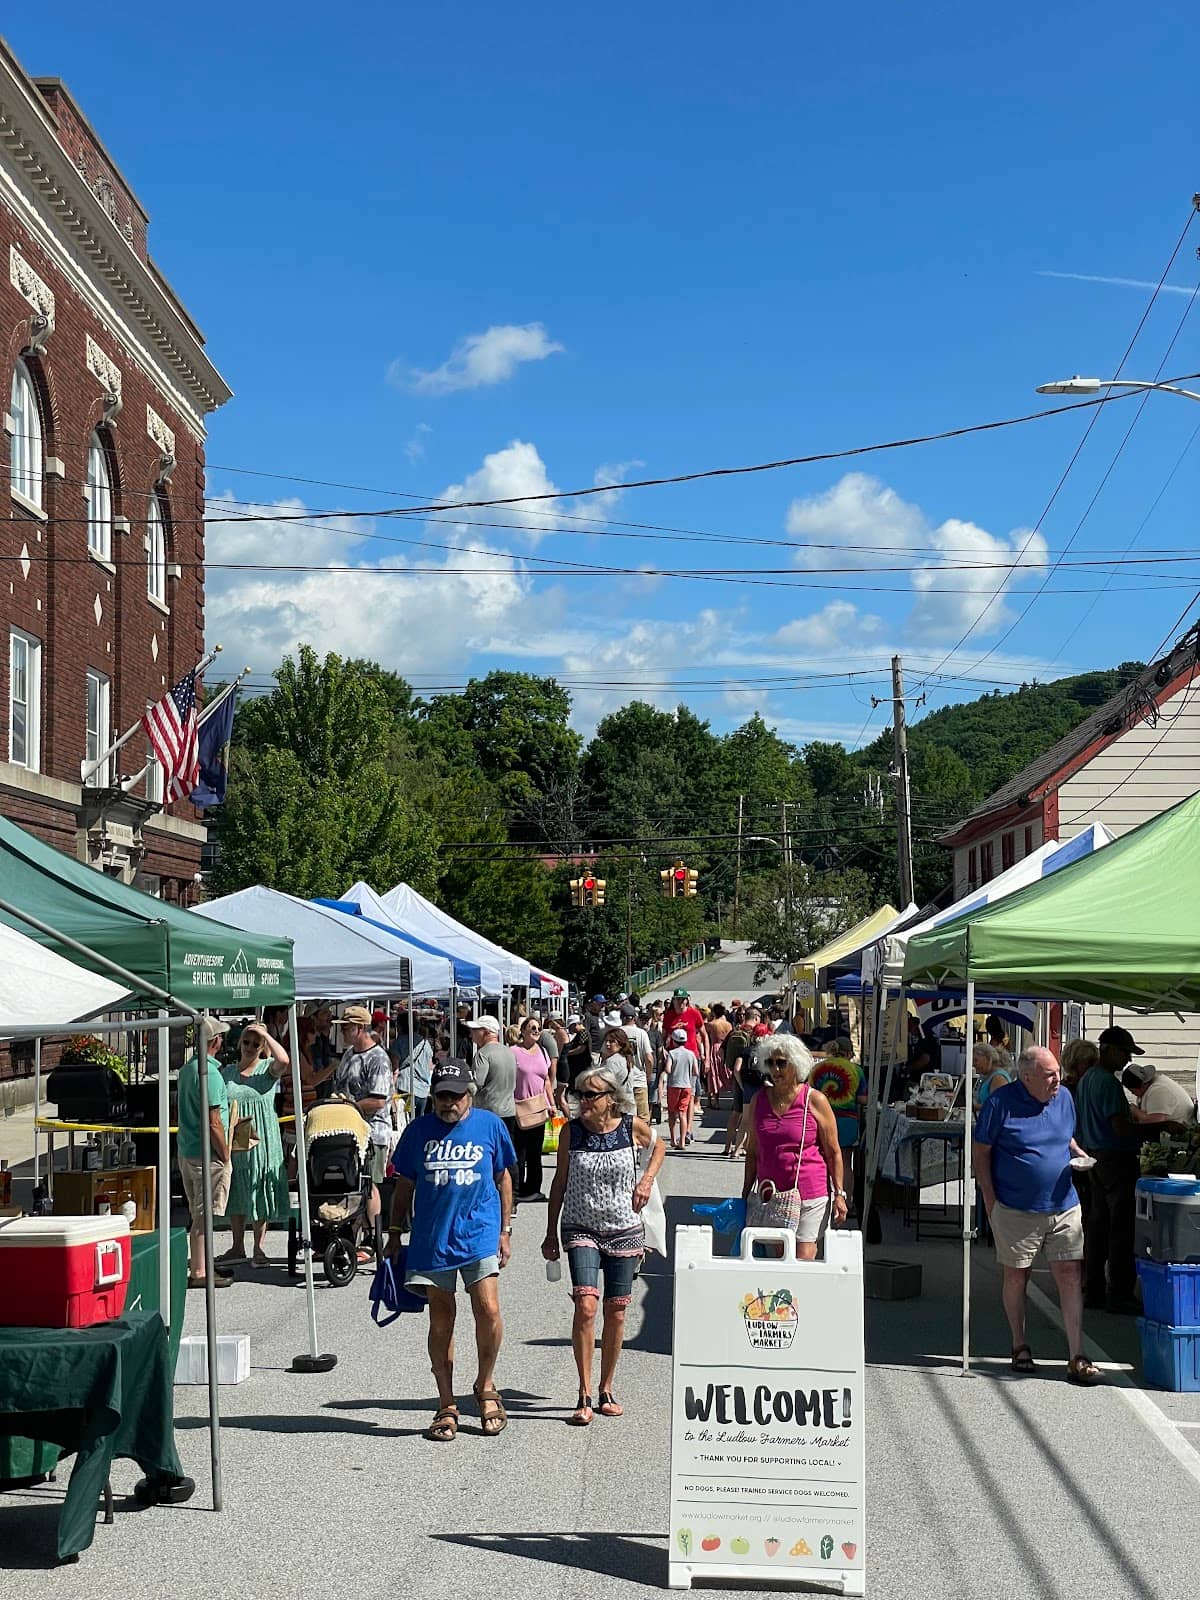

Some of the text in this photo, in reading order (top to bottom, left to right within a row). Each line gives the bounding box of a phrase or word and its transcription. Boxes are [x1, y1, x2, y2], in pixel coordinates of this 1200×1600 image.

[192, 971, 216, 986] SPIRITS
[261, 972, 280, 985] SPIRITS
[423, 1139, 484, 1161] Pilots
[747, 1321, 778, 1329] LUDLOW
[759, 1330, 792, 1339] FARMERS
[753, 1338, 782, 1348] MARKET
[684, 1383, 852, 1429] WELCOME!
[684, 1429, 851, 1448] to the Ludlow Farmers Market
[699, 1454, 725, 1462] THANK
[760, 1456, 807, 1465] SUPPORTING
[808, 1459, 835, 1467] LOCAL!
